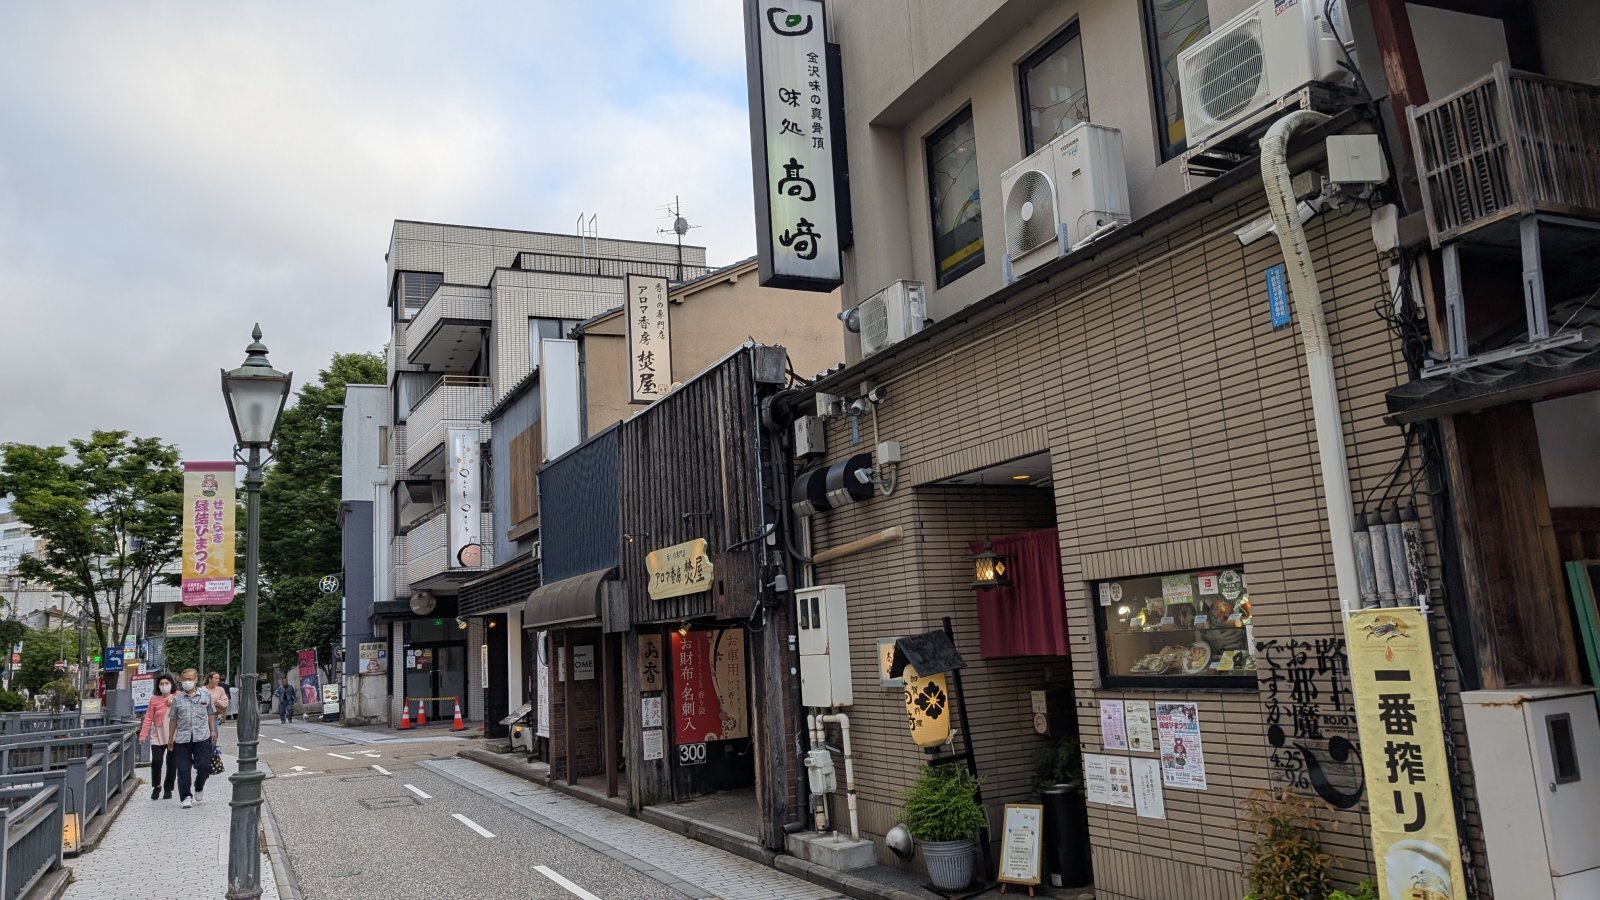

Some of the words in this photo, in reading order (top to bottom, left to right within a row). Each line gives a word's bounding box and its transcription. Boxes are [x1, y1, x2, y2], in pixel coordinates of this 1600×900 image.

[778, 87, 805, 137] 味処
[806, 51, 825, 150] 金沢味の真骨頂
[638, 285, 651, 346] アロマ香房
[655, 282, 666, 340] 香りの専門店
[637, 350, 658, 395] 焚屋
[194, 499, 209, 576] 縁結びまつり
[212, 499, 225, 544] せせらぎ
[684, 556, 705, 585] 焚屋
[643, 642, 660, 684] お香
[726, 635, 739, 676] お車用
[680, 638, 696, 732] お財布・名刺入
[910, 675, 923, 728] 加賀料理
[1286, 638, 1323, 740] お邪魔
[1323, 715, 1349, 725] ROJO
[680, 744, 705, 762] 300
[1374, 669, 1427, 833] 一番搾り
